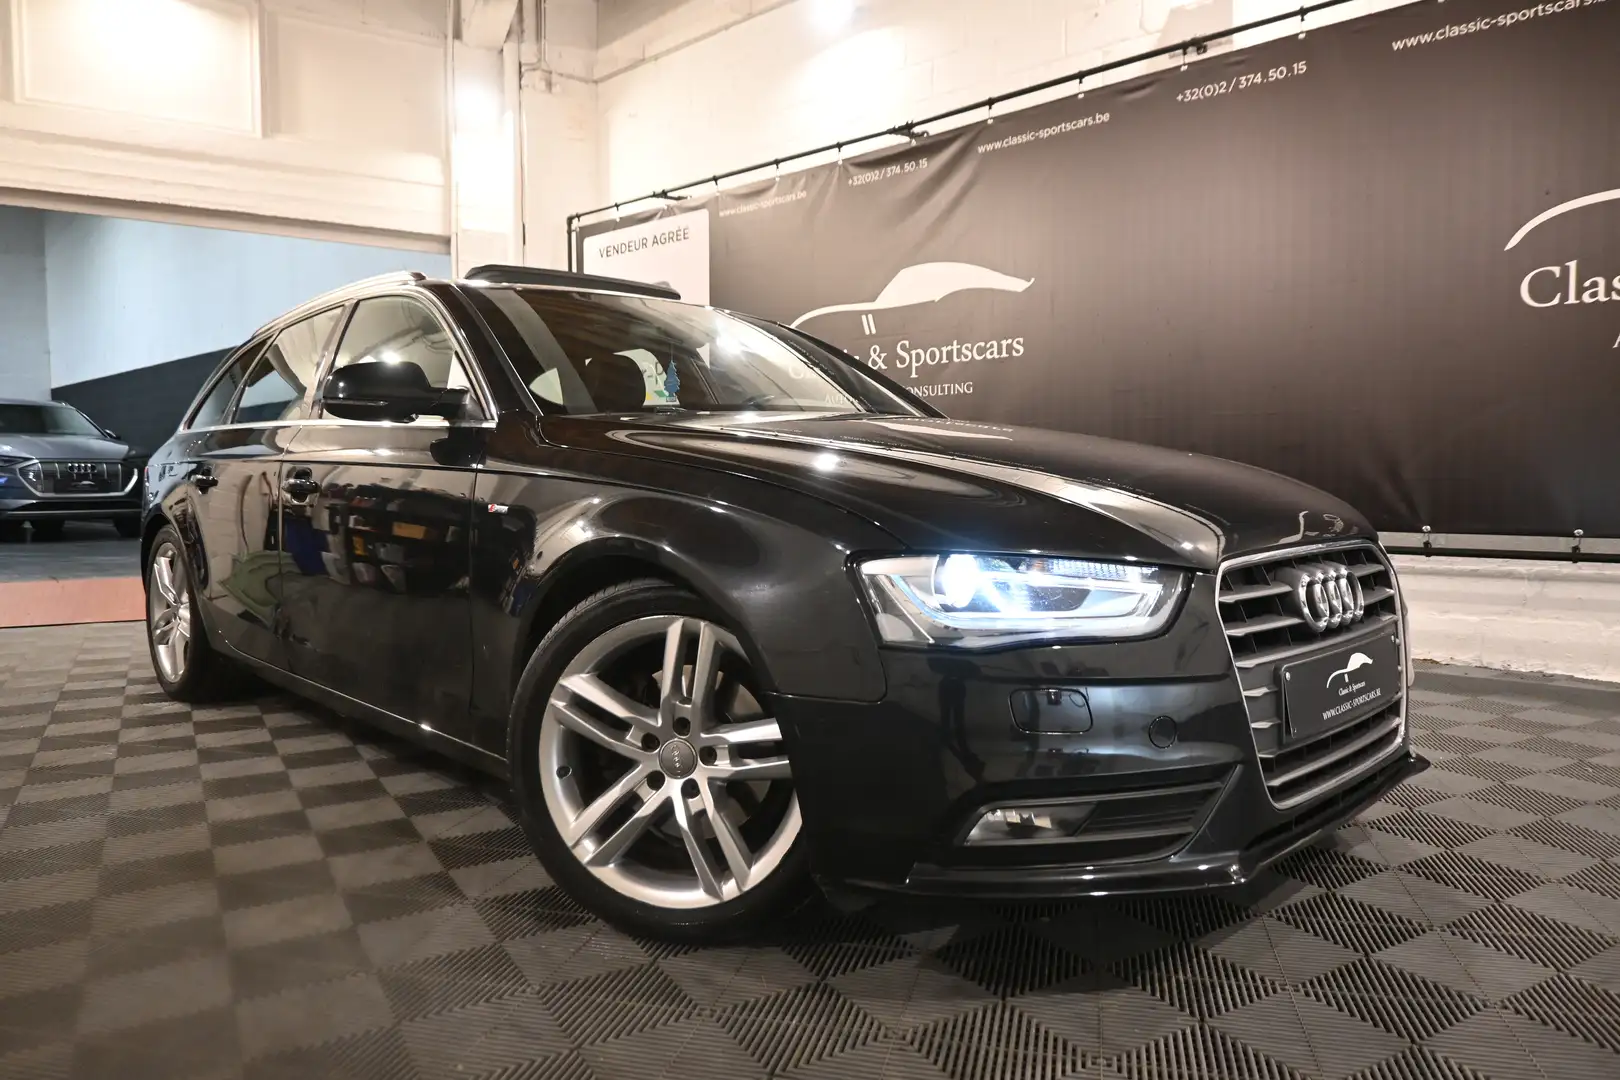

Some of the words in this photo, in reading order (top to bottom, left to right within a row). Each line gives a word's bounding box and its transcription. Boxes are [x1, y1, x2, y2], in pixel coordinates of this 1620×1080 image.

[977, 111, 1111, 154] www.classic-sportscars.be
[598, 236, 648, 259] VENDEUR
[651, 225, 690, 248] AGRÉE
[867, 343, 888, 371] &
[896, 337, 1024, 378] Sportscars
[1322, 687, 1382, 720] WWW.CLASSIC-SPORTSCARS.BE
